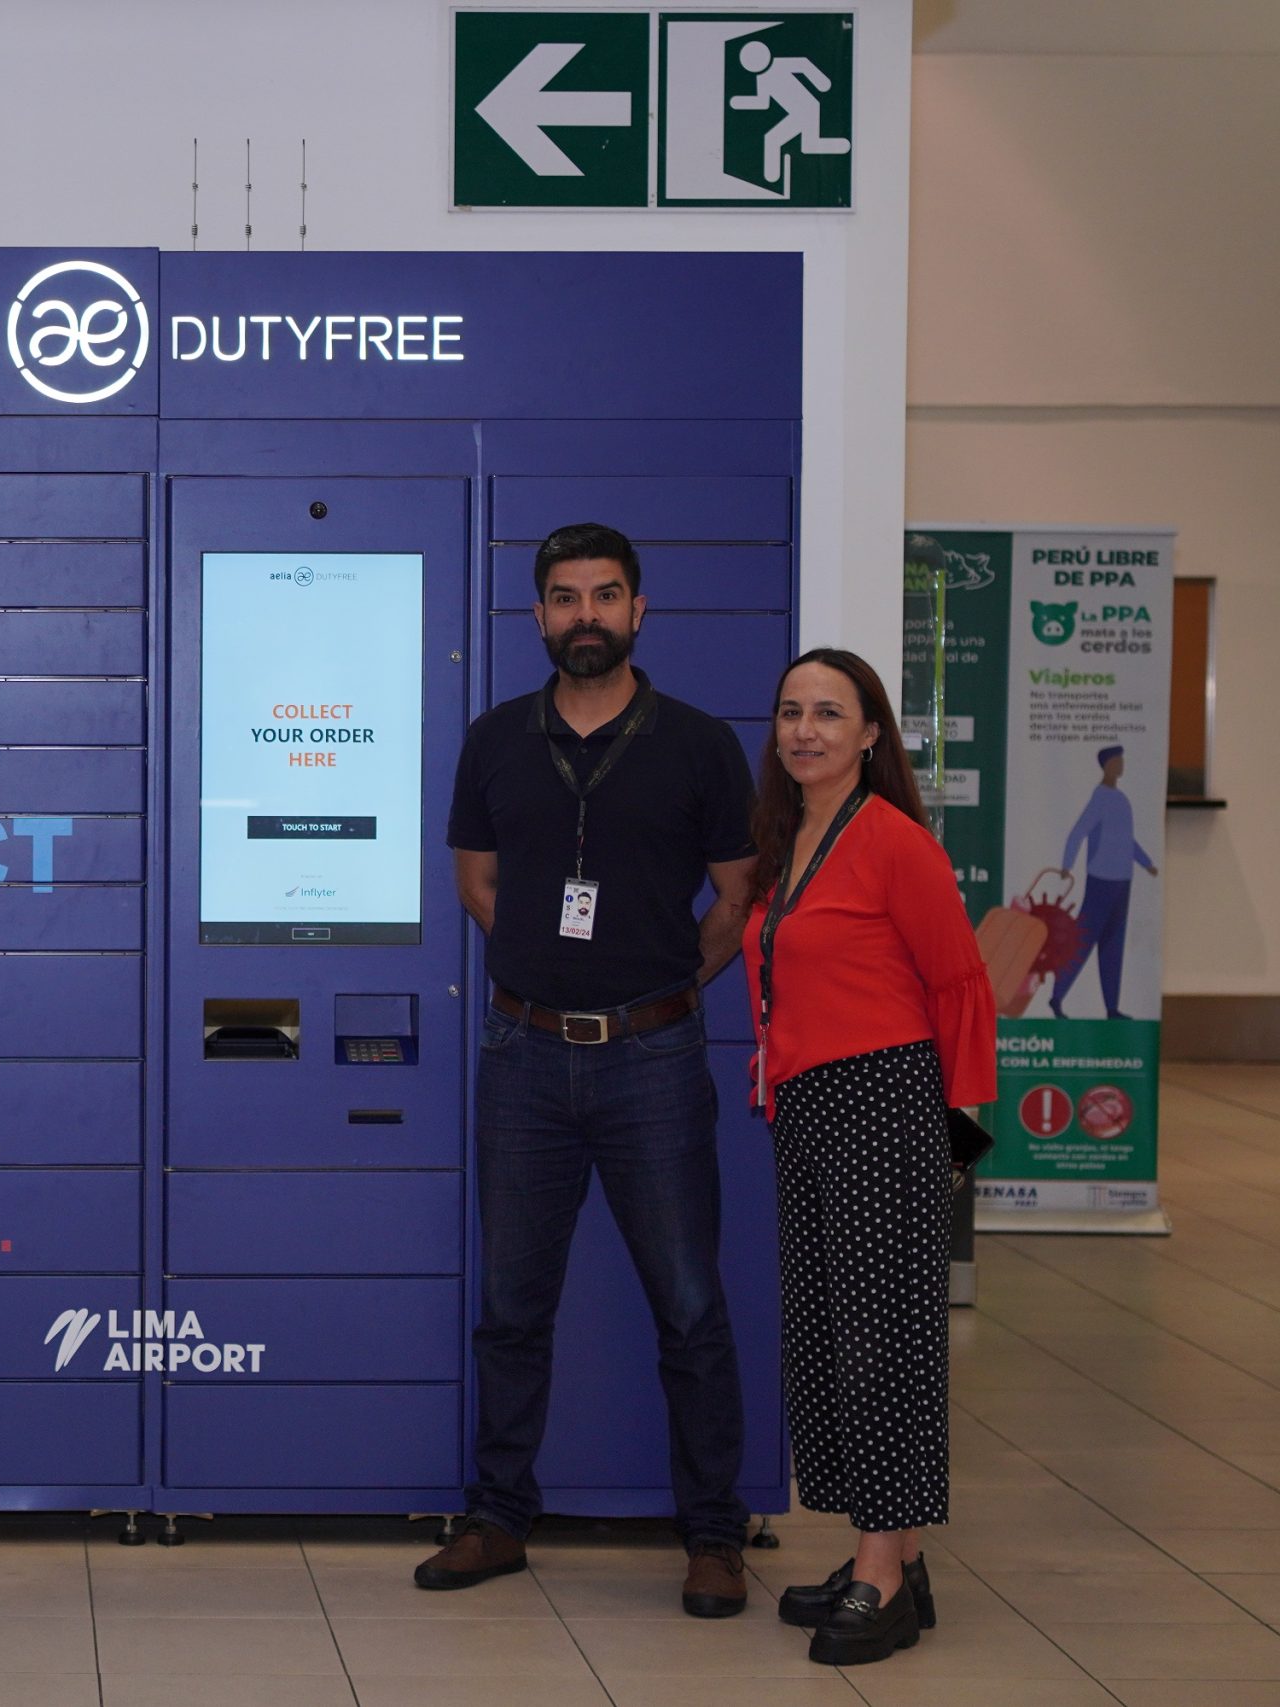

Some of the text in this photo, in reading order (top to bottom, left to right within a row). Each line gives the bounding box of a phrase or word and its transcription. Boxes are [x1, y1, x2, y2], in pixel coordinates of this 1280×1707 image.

[172, 316, 464, 361] DUTYFREE
[1032, 546, 1160, 567] PERÚ LIBRE
[270, 572, 292, 580] aelia
[316, 573, 358, 581] DUTYFREE
[1054, 571, 1136, 587] DE PPA
[1081, 605, 1151, 622] La PPA
[1081, 628, 1115, 638] mata
[1132, 628, 1152, 638] los
[960, 637, 985, 647] una
[1080, 639, 1152, 654] cerdos
[961, 651, 979, 663] de
[1029, 668, 1116, 688] Viajeros
[272, 704, 353, 719] COLLECT
[251, 728, 375, 744] YOUR ORDER
[289, 752, 337, 767] HERE
[282, 824, 342, 832] TOUCH TO START
[970, 865, 989, 882] la
[995, 1036, 1054, 1052] NCIÓN
[1001, 1057, 1143, 1070] CON LA ENFERMEDAD
[108, 1310, 205, 1339] LIMA
[103, 1343, 266, 1373] AIRPORT
